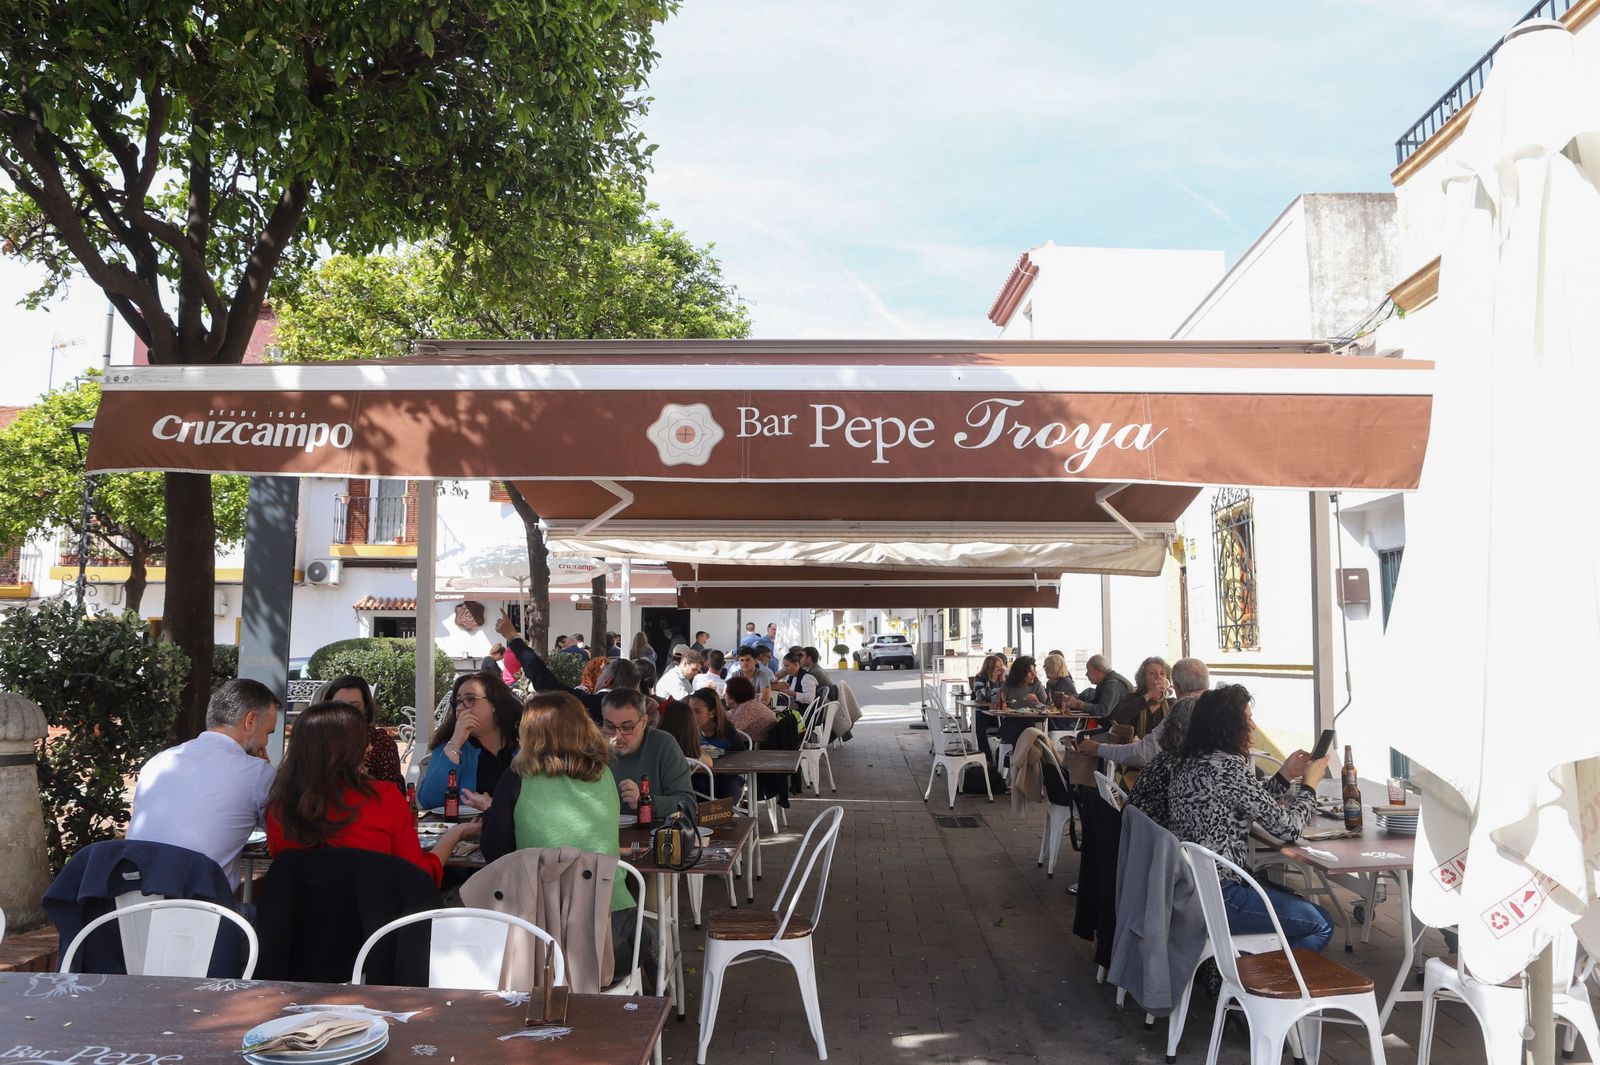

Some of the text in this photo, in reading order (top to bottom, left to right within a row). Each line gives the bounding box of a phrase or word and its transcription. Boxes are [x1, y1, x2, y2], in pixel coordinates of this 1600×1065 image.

[208, 409, 307, 419] DESDE 1904
[151, 414, 354, 453] Cruzcampo
[735, 397, 1169, 474] Bar Pepe Troya
[701, 811, 731, 822] RESERVADO
[0, 1045, 184, 1065] Bar Pepe
